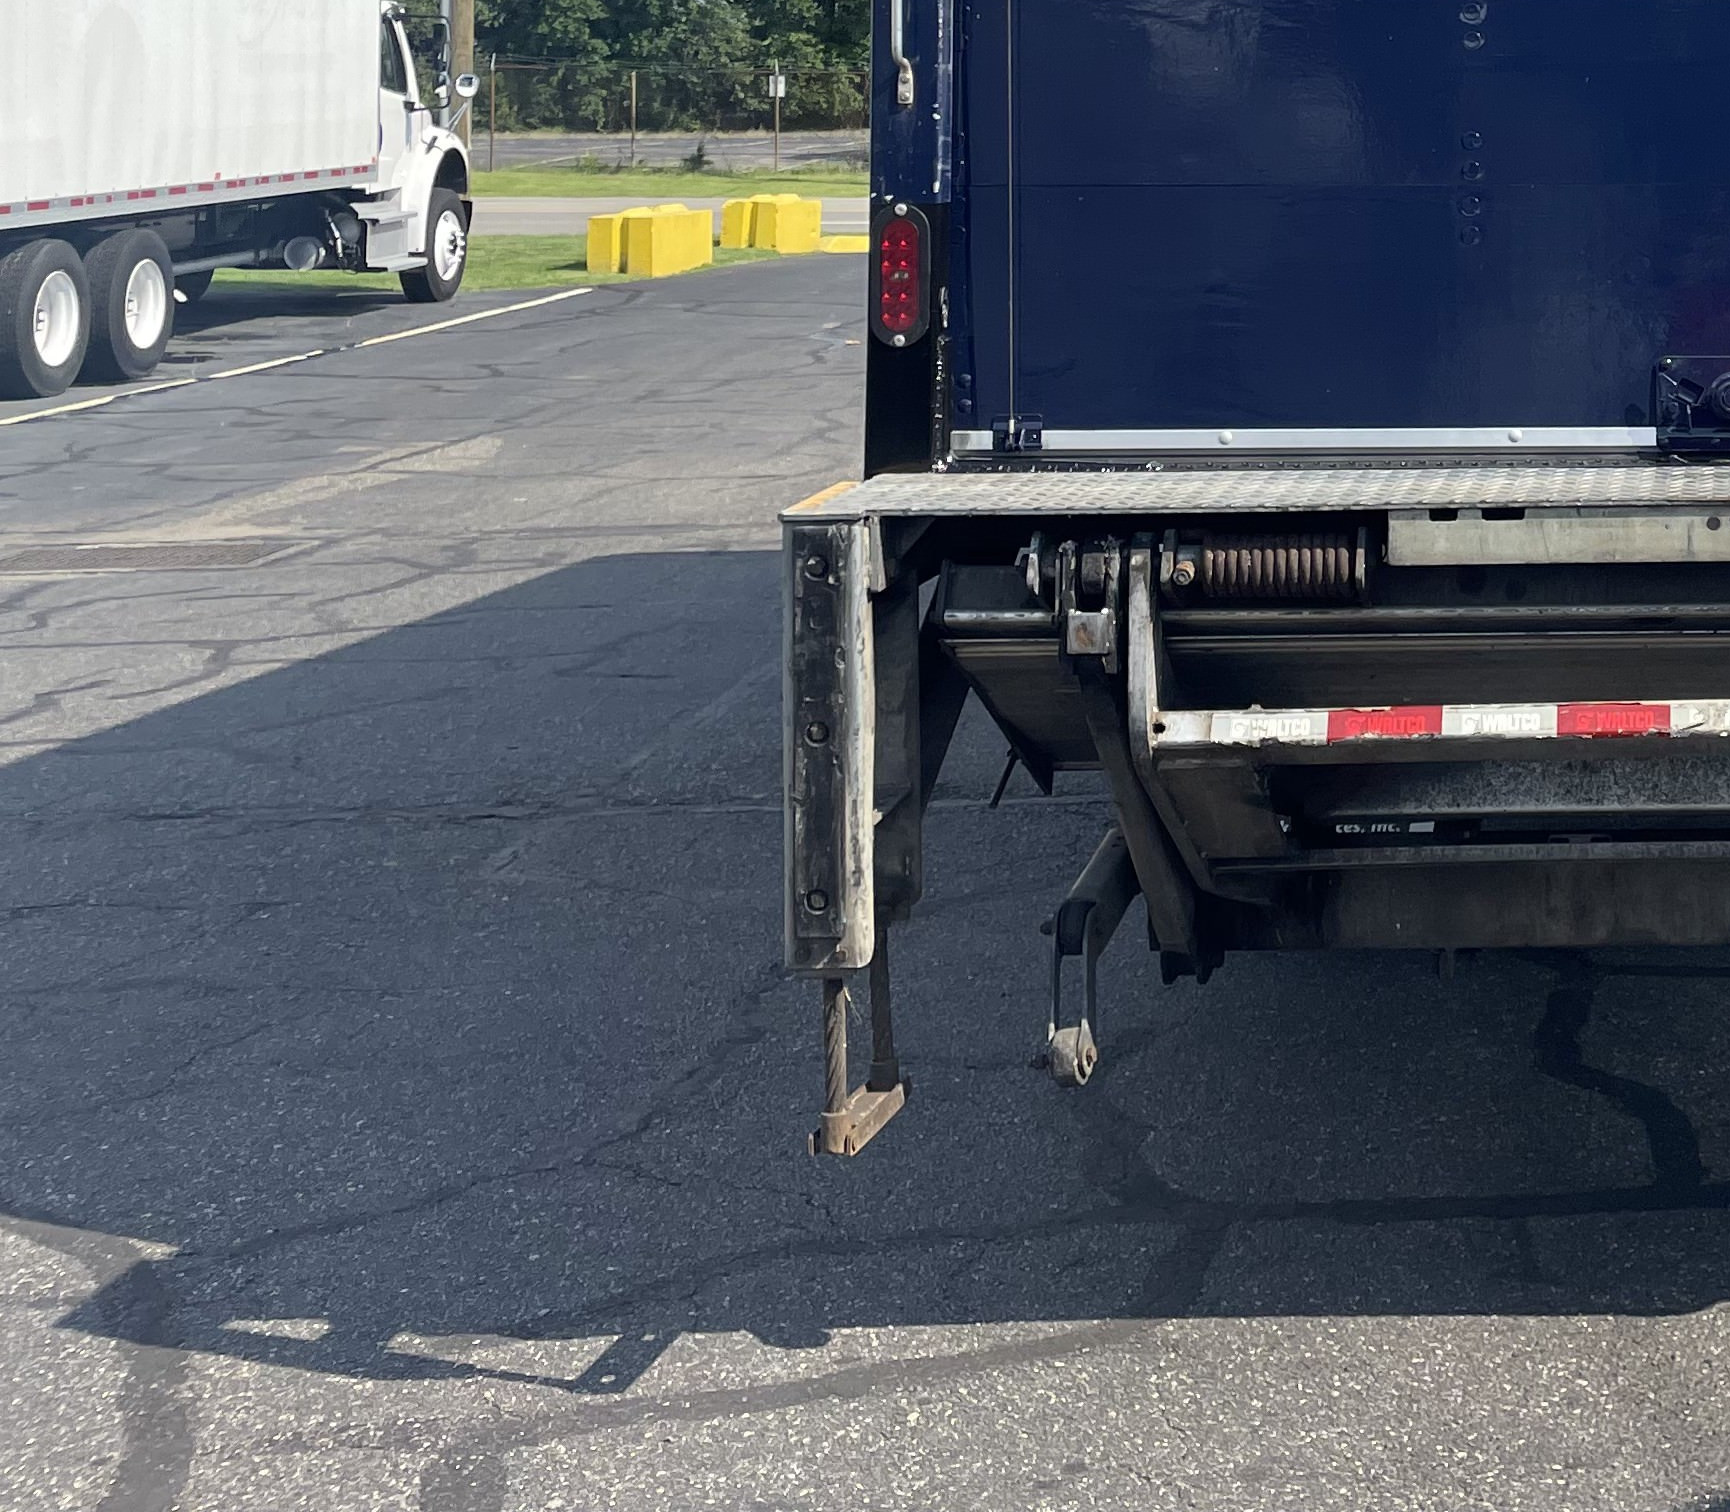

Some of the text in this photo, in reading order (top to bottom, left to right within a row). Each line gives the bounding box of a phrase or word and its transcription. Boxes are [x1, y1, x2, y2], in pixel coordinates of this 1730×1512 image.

[1368, 716, 1425, 733] WALTCO
[1482, 713, 1540, 731] WALTCO
[1597, 711, 1655, 729] WALTCO
